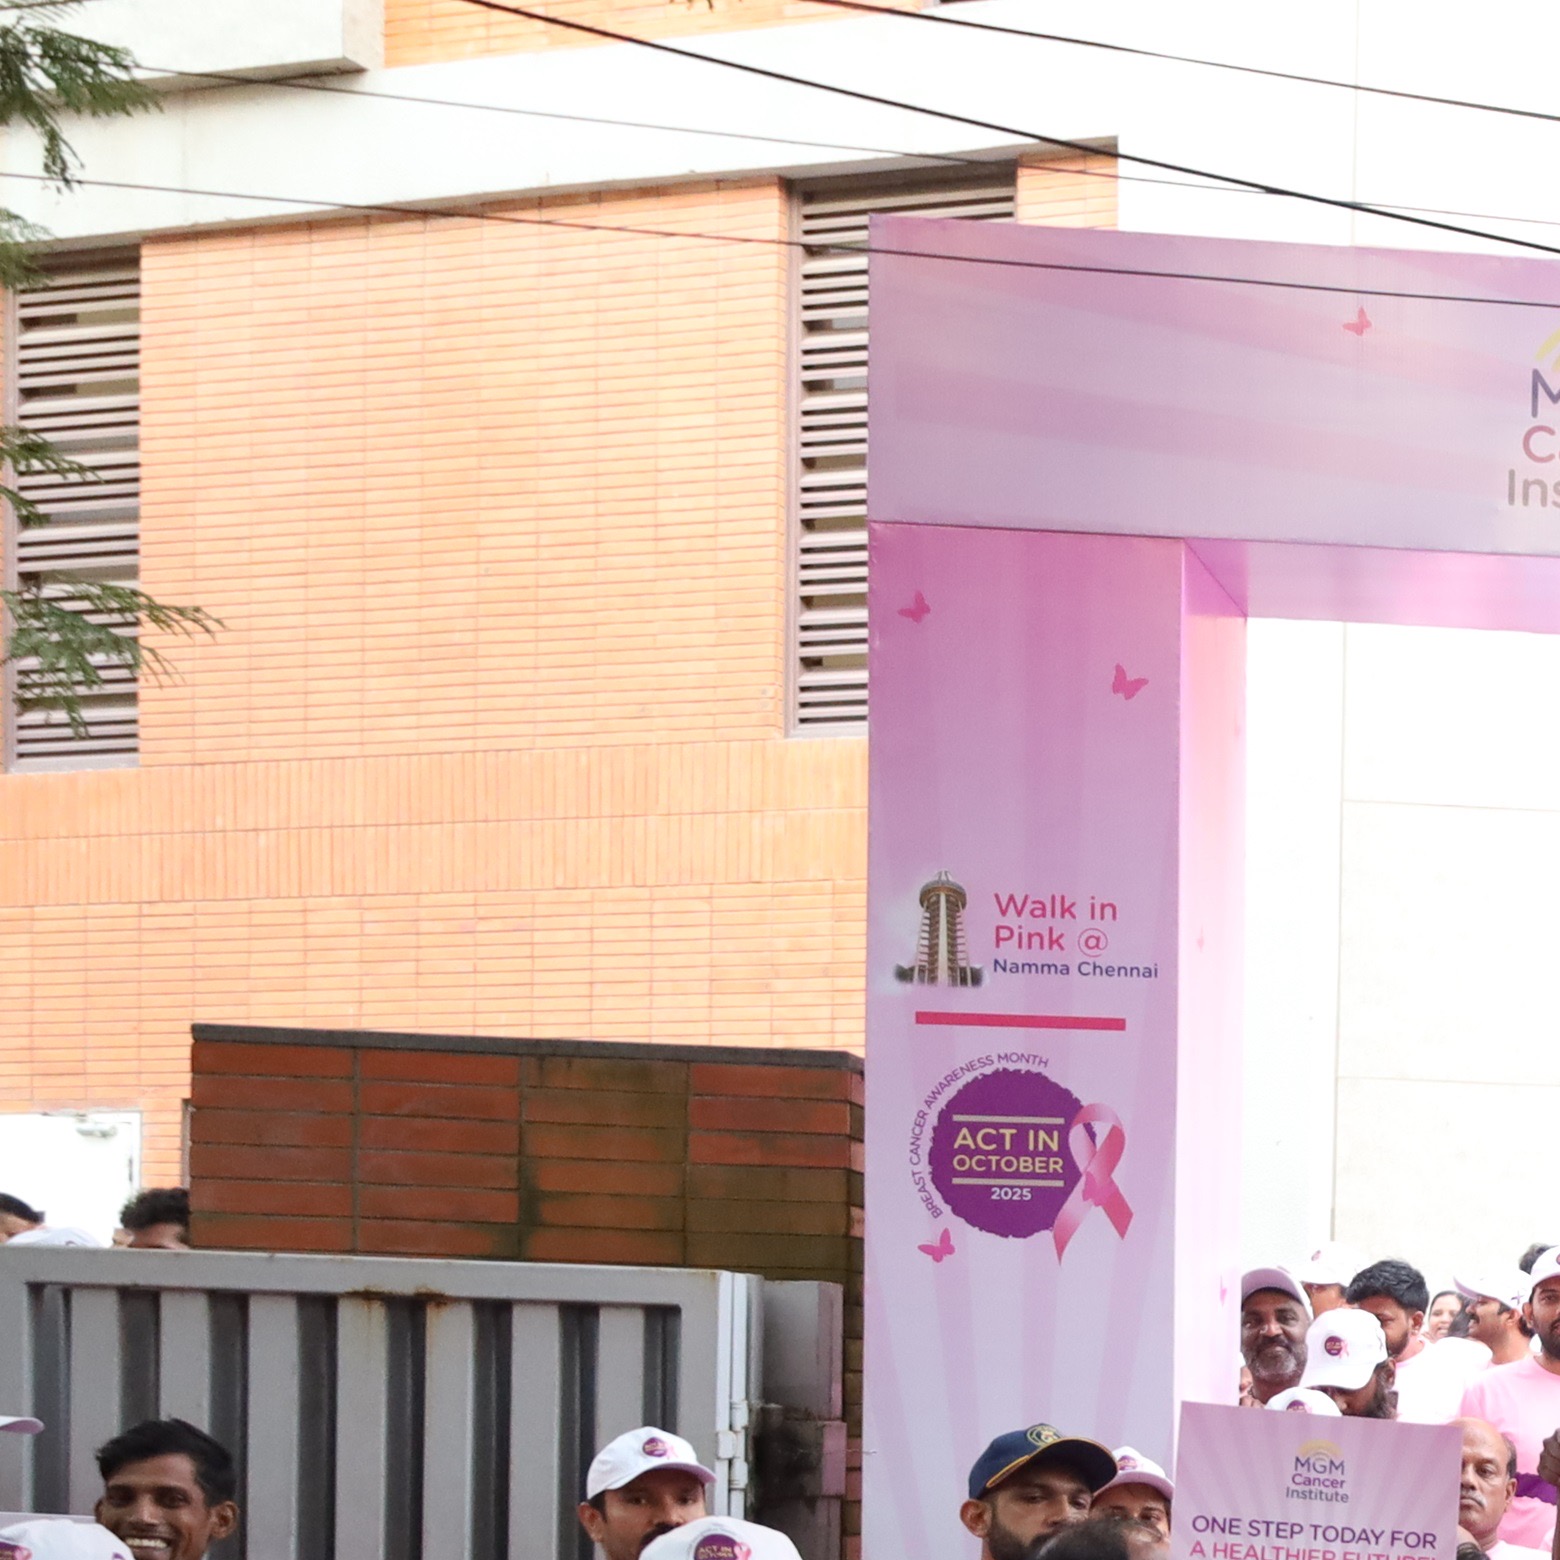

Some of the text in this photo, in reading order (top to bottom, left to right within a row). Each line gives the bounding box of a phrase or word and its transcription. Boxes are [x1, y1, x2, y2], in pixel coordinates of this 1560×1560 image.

[994, 892, 1118, 922] Walk in
[994, 925, 1109, 958] Pink @
[993, 958, 1159, 979] Namma Chennai
[909, 1052, 1050, 1219] BREAST CANCER AWARENESS MONTH
[953, 1127, 1060, 1152] ACT IN
[952, 1155, 1064, 1174] OCTOBER
[990, 1187, 1033, 1201] 2025
[1294, 1456, 1346, 1476] MGM
[1291, 1473, 1346, 1490] Cancer
[1285, 1487, 1350, 1504] Institute
[1192, 1514, 1438, 1550] ONE STEP TODAY FOR
[1189, 1540, 1206, 1558] A
